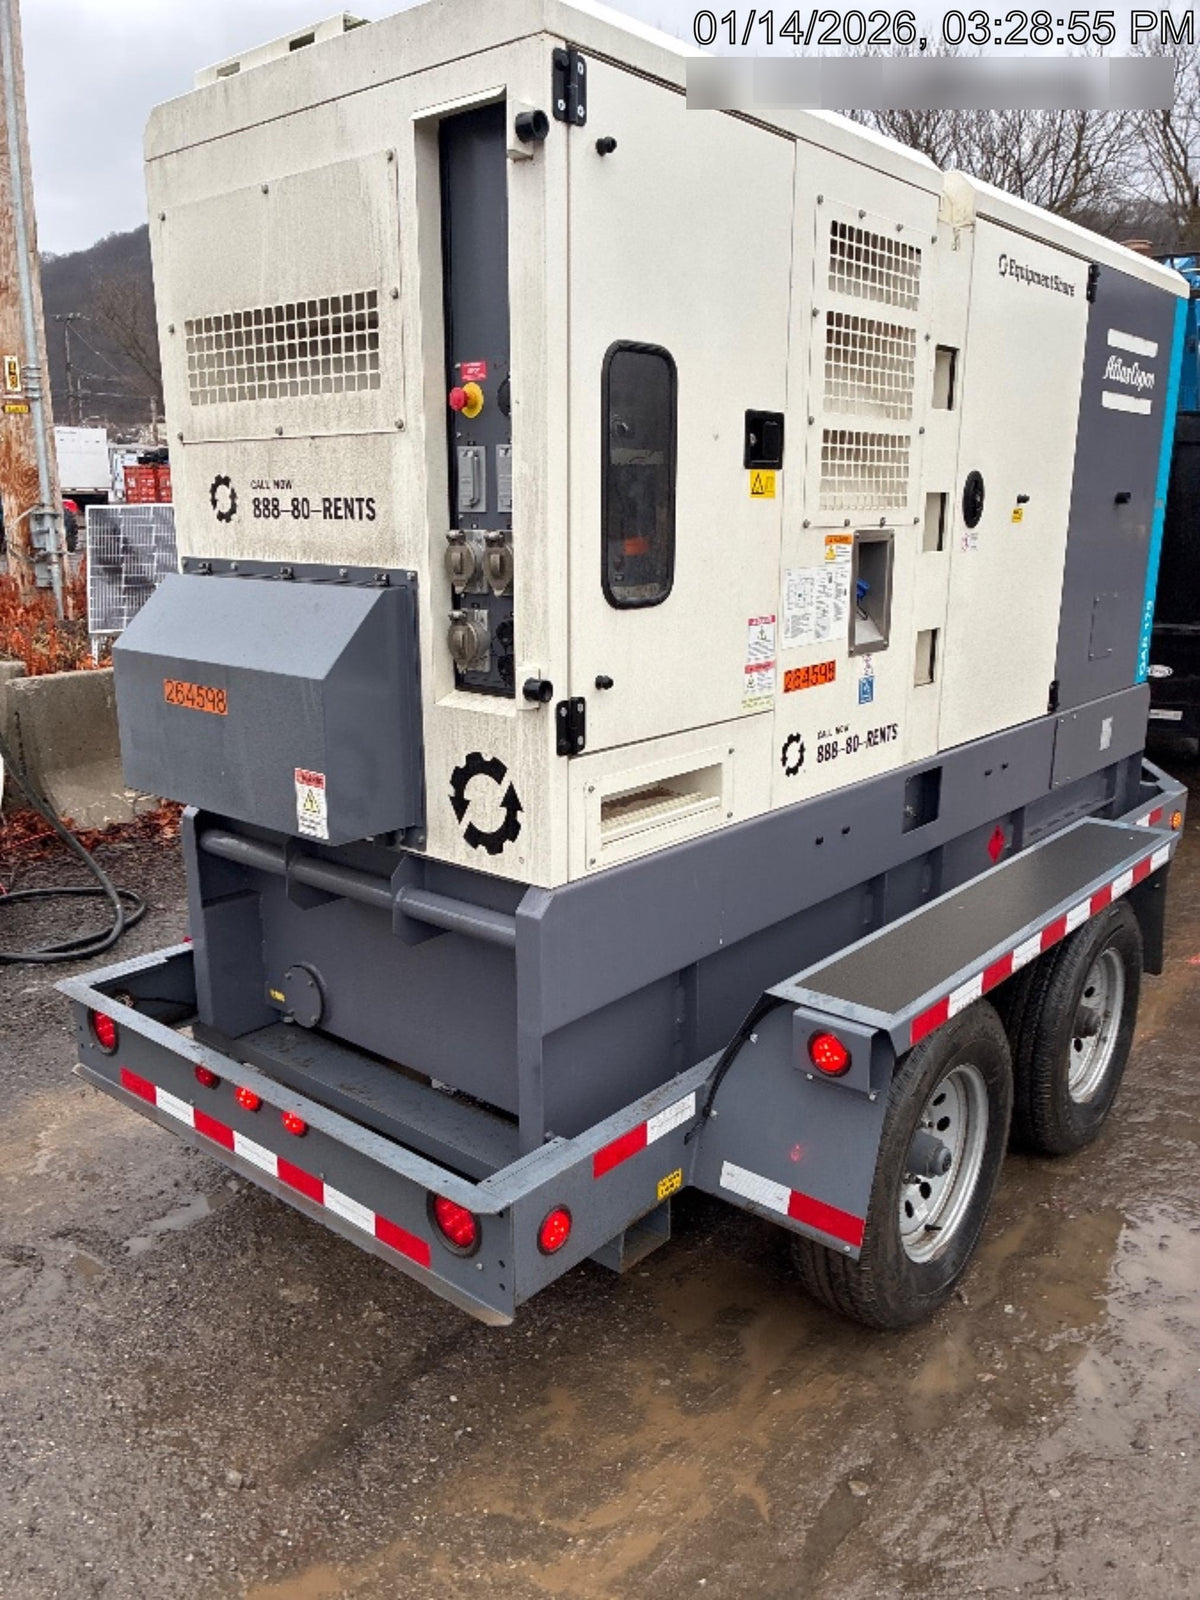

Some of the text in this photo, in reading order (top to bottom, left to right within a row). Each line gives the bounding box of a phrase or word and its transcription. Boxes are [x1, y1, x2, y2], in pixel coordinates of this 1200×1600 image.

[251, 479, 292, 490] CALL NOW
[252, 497, 376, 522] 888-80-RENTS
[783, 659, 836, 694] 264598
[165, 680, 227, 714] 264598
[816, 722, 898, 764] 888-80-RENTS
